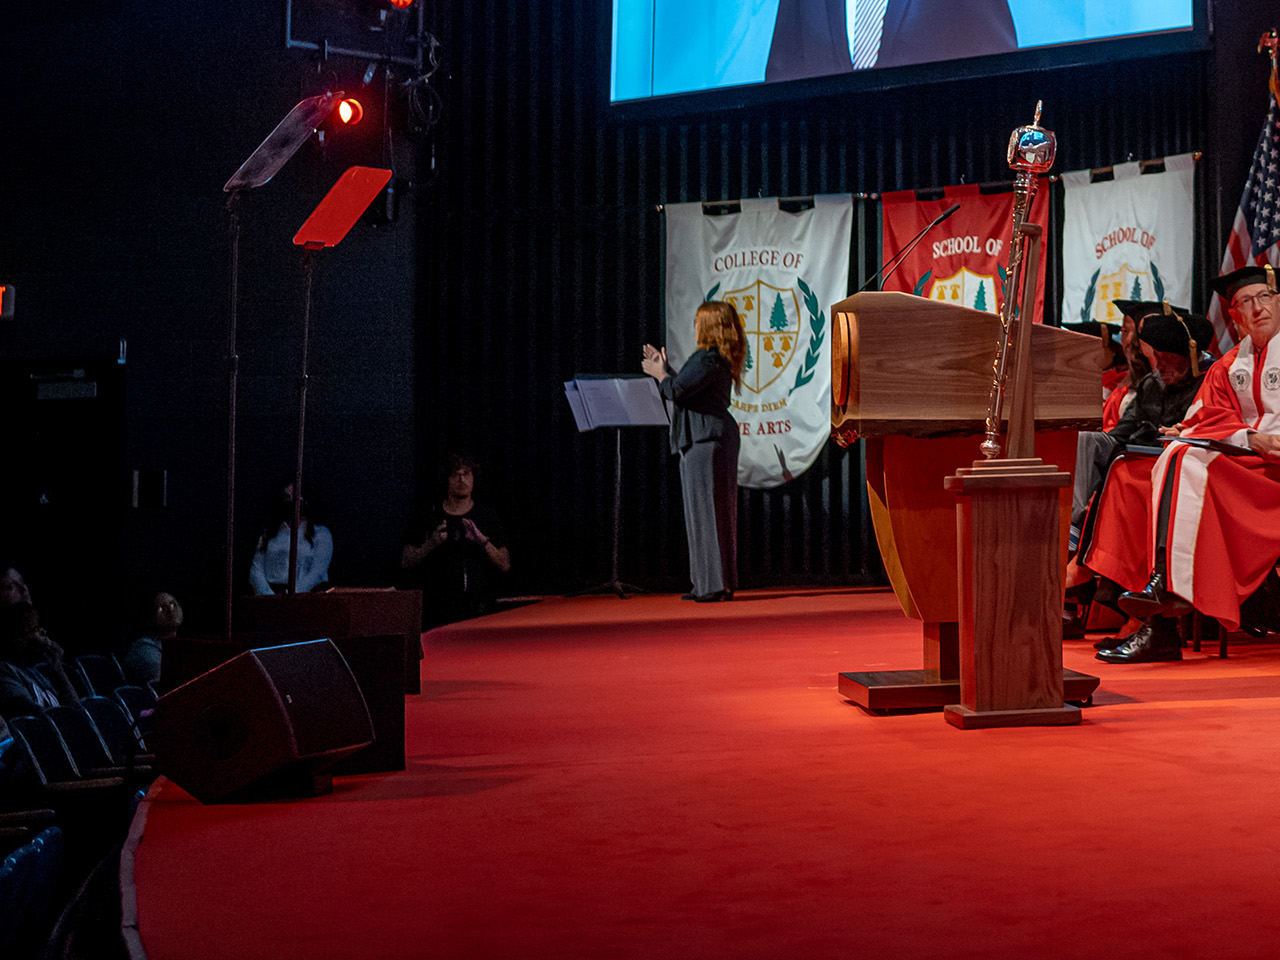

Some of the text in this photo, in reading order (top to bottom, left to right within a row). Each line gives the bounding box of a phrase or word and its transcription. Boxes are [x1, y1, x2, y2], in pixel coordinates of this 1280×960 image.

[932, 236, 1003, 259] SCHOOL OF
[1095, 227, 1156, 259] SCHOOL OF
[714, 249, 804, 272] COLLEGE OF
[761, 397, 787, 413] DIEM
[757, 419, 792, 436] ARTS
